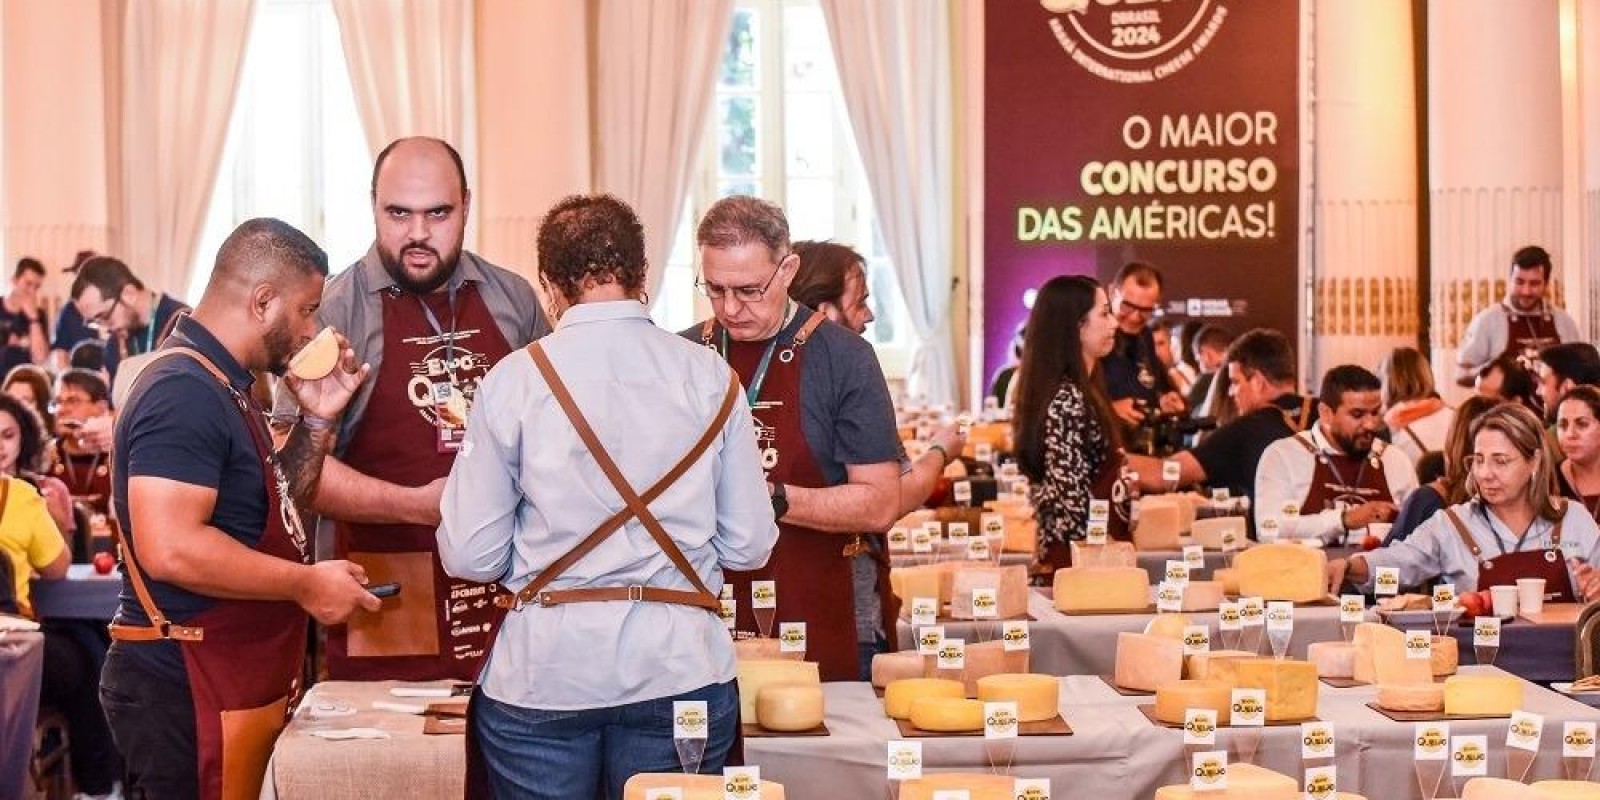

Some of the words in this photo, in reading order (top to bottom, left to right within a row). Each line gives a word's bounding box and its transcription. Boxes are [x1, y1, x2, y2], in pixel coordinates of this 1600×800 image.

[1111, 26, 1161, 47] 2024
[1123, 115, 1151, 149] O
[1160, 111, 1277, 147] MAIOR
[1080, 157, 1277, 195] CONCURSO
[1017, 207, 1083, 241] DAS
[1089, 200, 1275, 240] AMÉRICAS!
